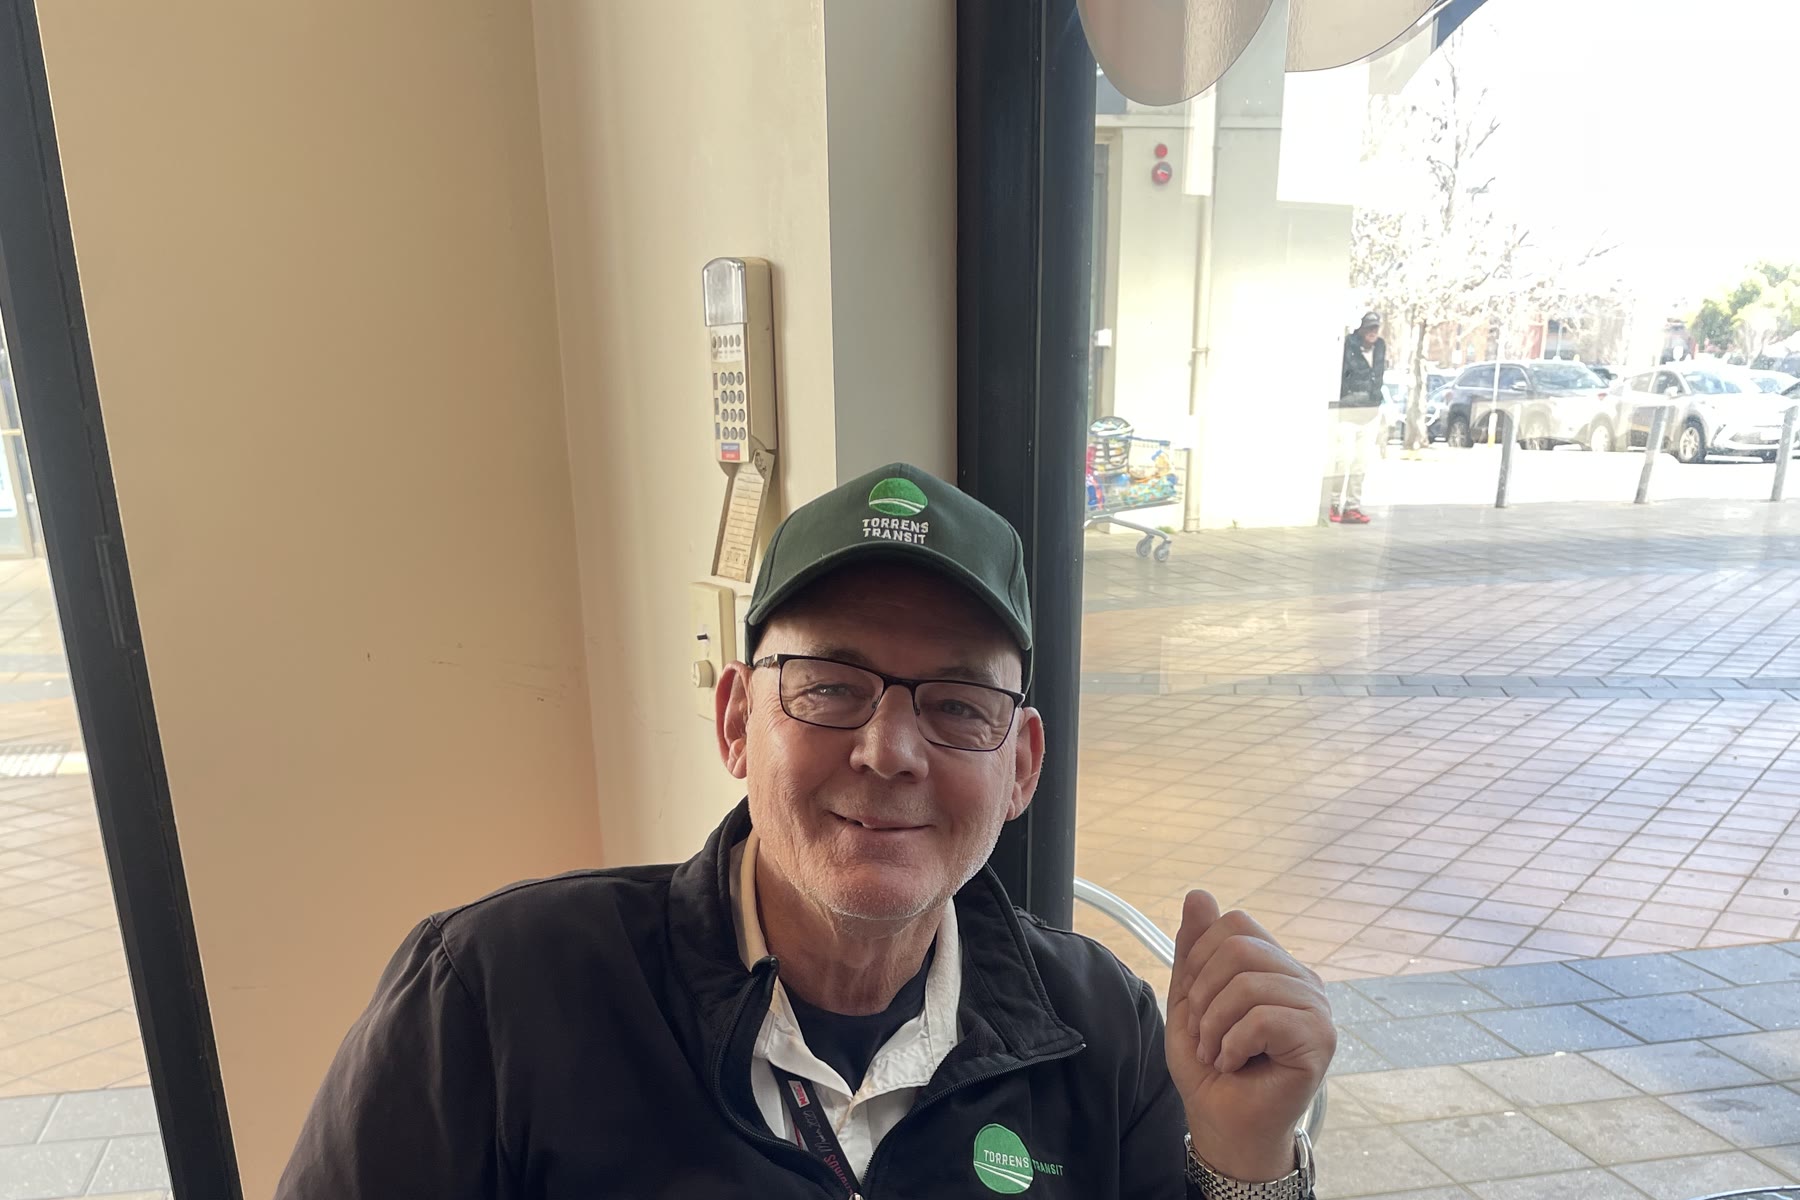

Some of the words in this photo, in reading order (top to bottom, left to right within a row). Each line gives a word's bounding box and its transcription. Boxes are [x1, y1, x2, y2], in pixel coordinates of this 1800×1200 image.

[862, 517, 929, 533] TORRENS
[862, 528, 926, 544] TRANSIT
[983, 1149, 1030, 1168] TORRENS
[1031, 1159, 1063, 1176] TRANSIT
